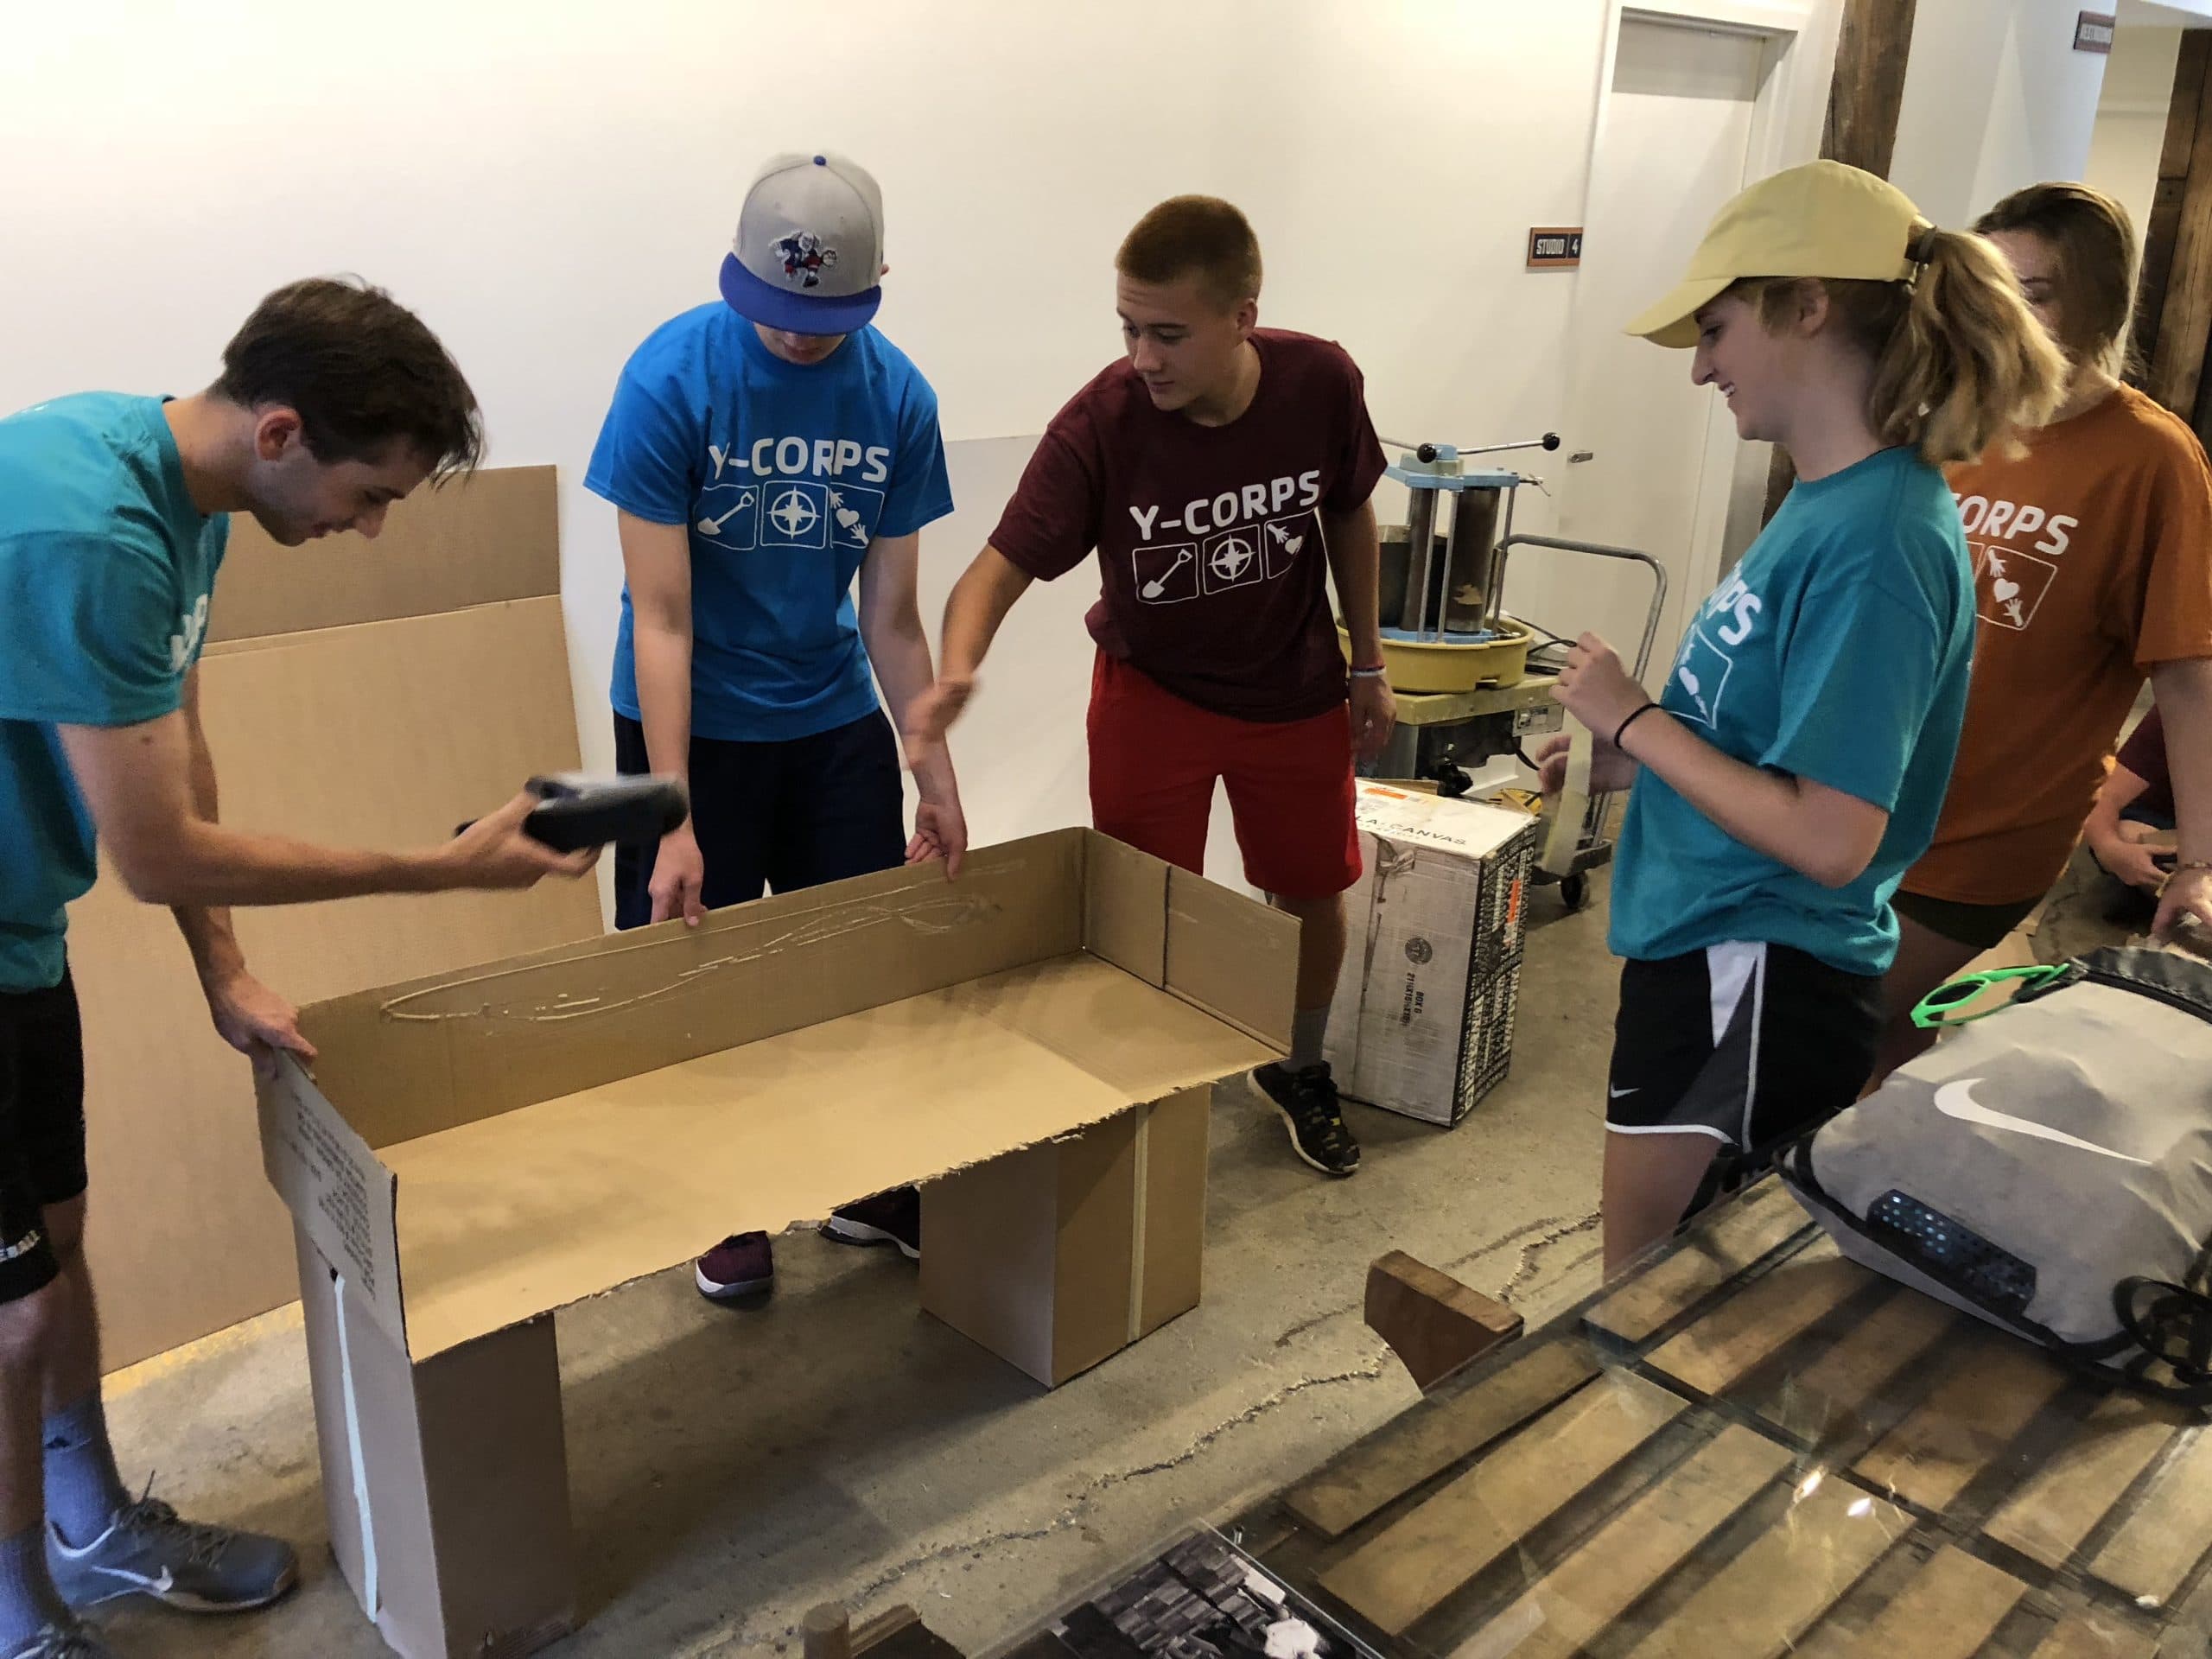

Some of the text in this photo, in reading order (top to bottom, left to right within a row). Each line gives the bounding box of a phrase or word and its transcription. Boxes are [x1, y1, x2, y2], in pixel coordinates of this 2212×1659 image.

[1536, 238, 1579, 255] STUDIO 4
[708, 435, 891, 483] Y-CORPS
[1128, 469, 1320, 541] Y-CORPS
[1952, 493, 2079, 556] ORPS
